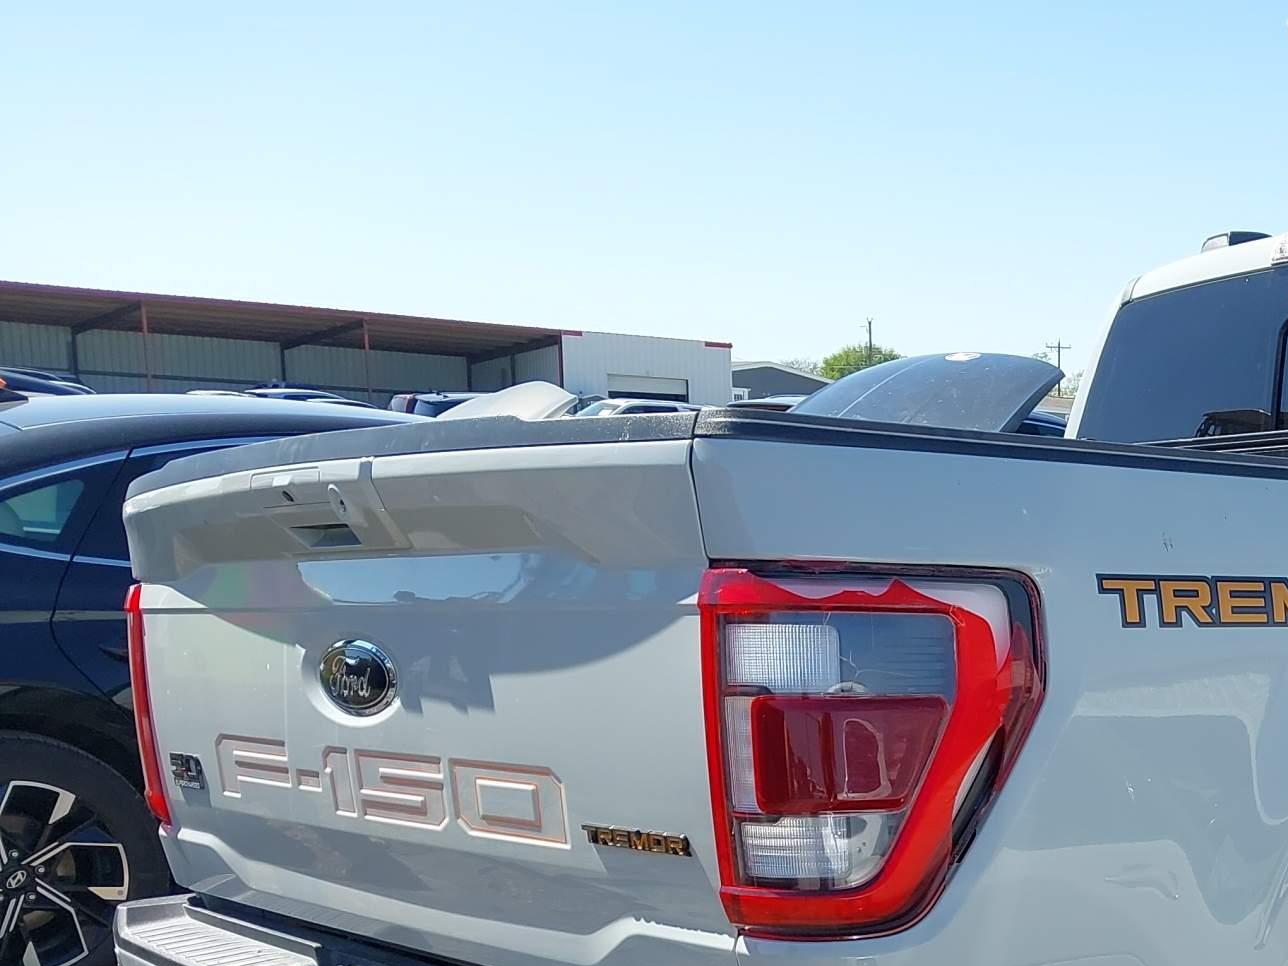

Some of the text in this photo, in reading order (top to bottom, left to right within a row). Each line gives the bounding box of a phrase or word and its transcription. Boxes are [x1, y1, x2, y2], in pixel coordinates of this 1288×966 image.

[329, 655, 371, 698] Ford
[214, 733, 572, 850] F-150
[581, 824, 693, 857] TREMOR
